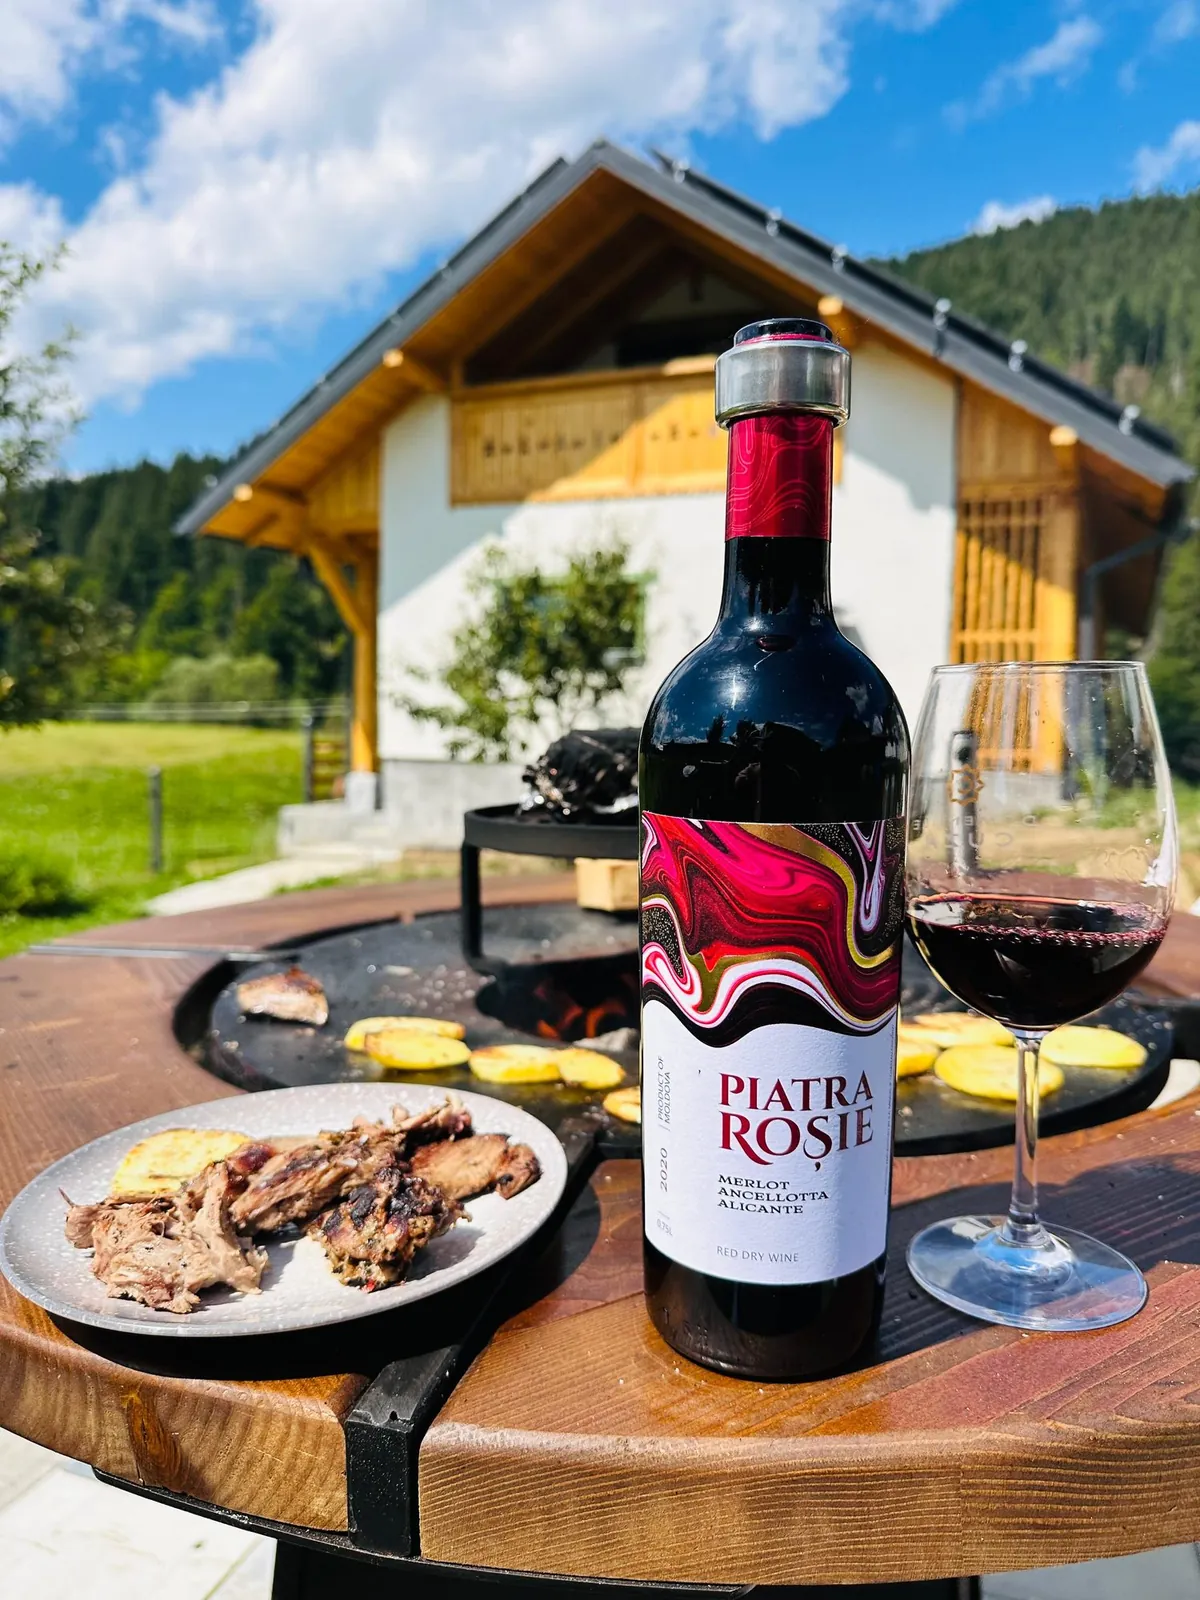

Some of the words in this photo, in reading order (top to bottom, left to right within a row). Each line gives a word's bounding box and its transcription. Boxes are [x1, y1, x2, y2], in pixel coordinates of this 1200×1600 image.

[657, 1055, 664, 1070] OF
[718, 1070, 874, 1112] PIATRA
[718, 1105, 874, 1172] ROȘIE
[660, 1147, 668, 1193] 2020
[718, 1174, 790, 1190] MERLOT
[718, 1187, 829, 1202] ANCELLOTTA
[718, 1199, 803, 1214] ALICANTE
[717, 1245, 738, 1258] RED
[742, 1251, 764, 1261] DRY
[768, 1252, 799, 1263] WINE
